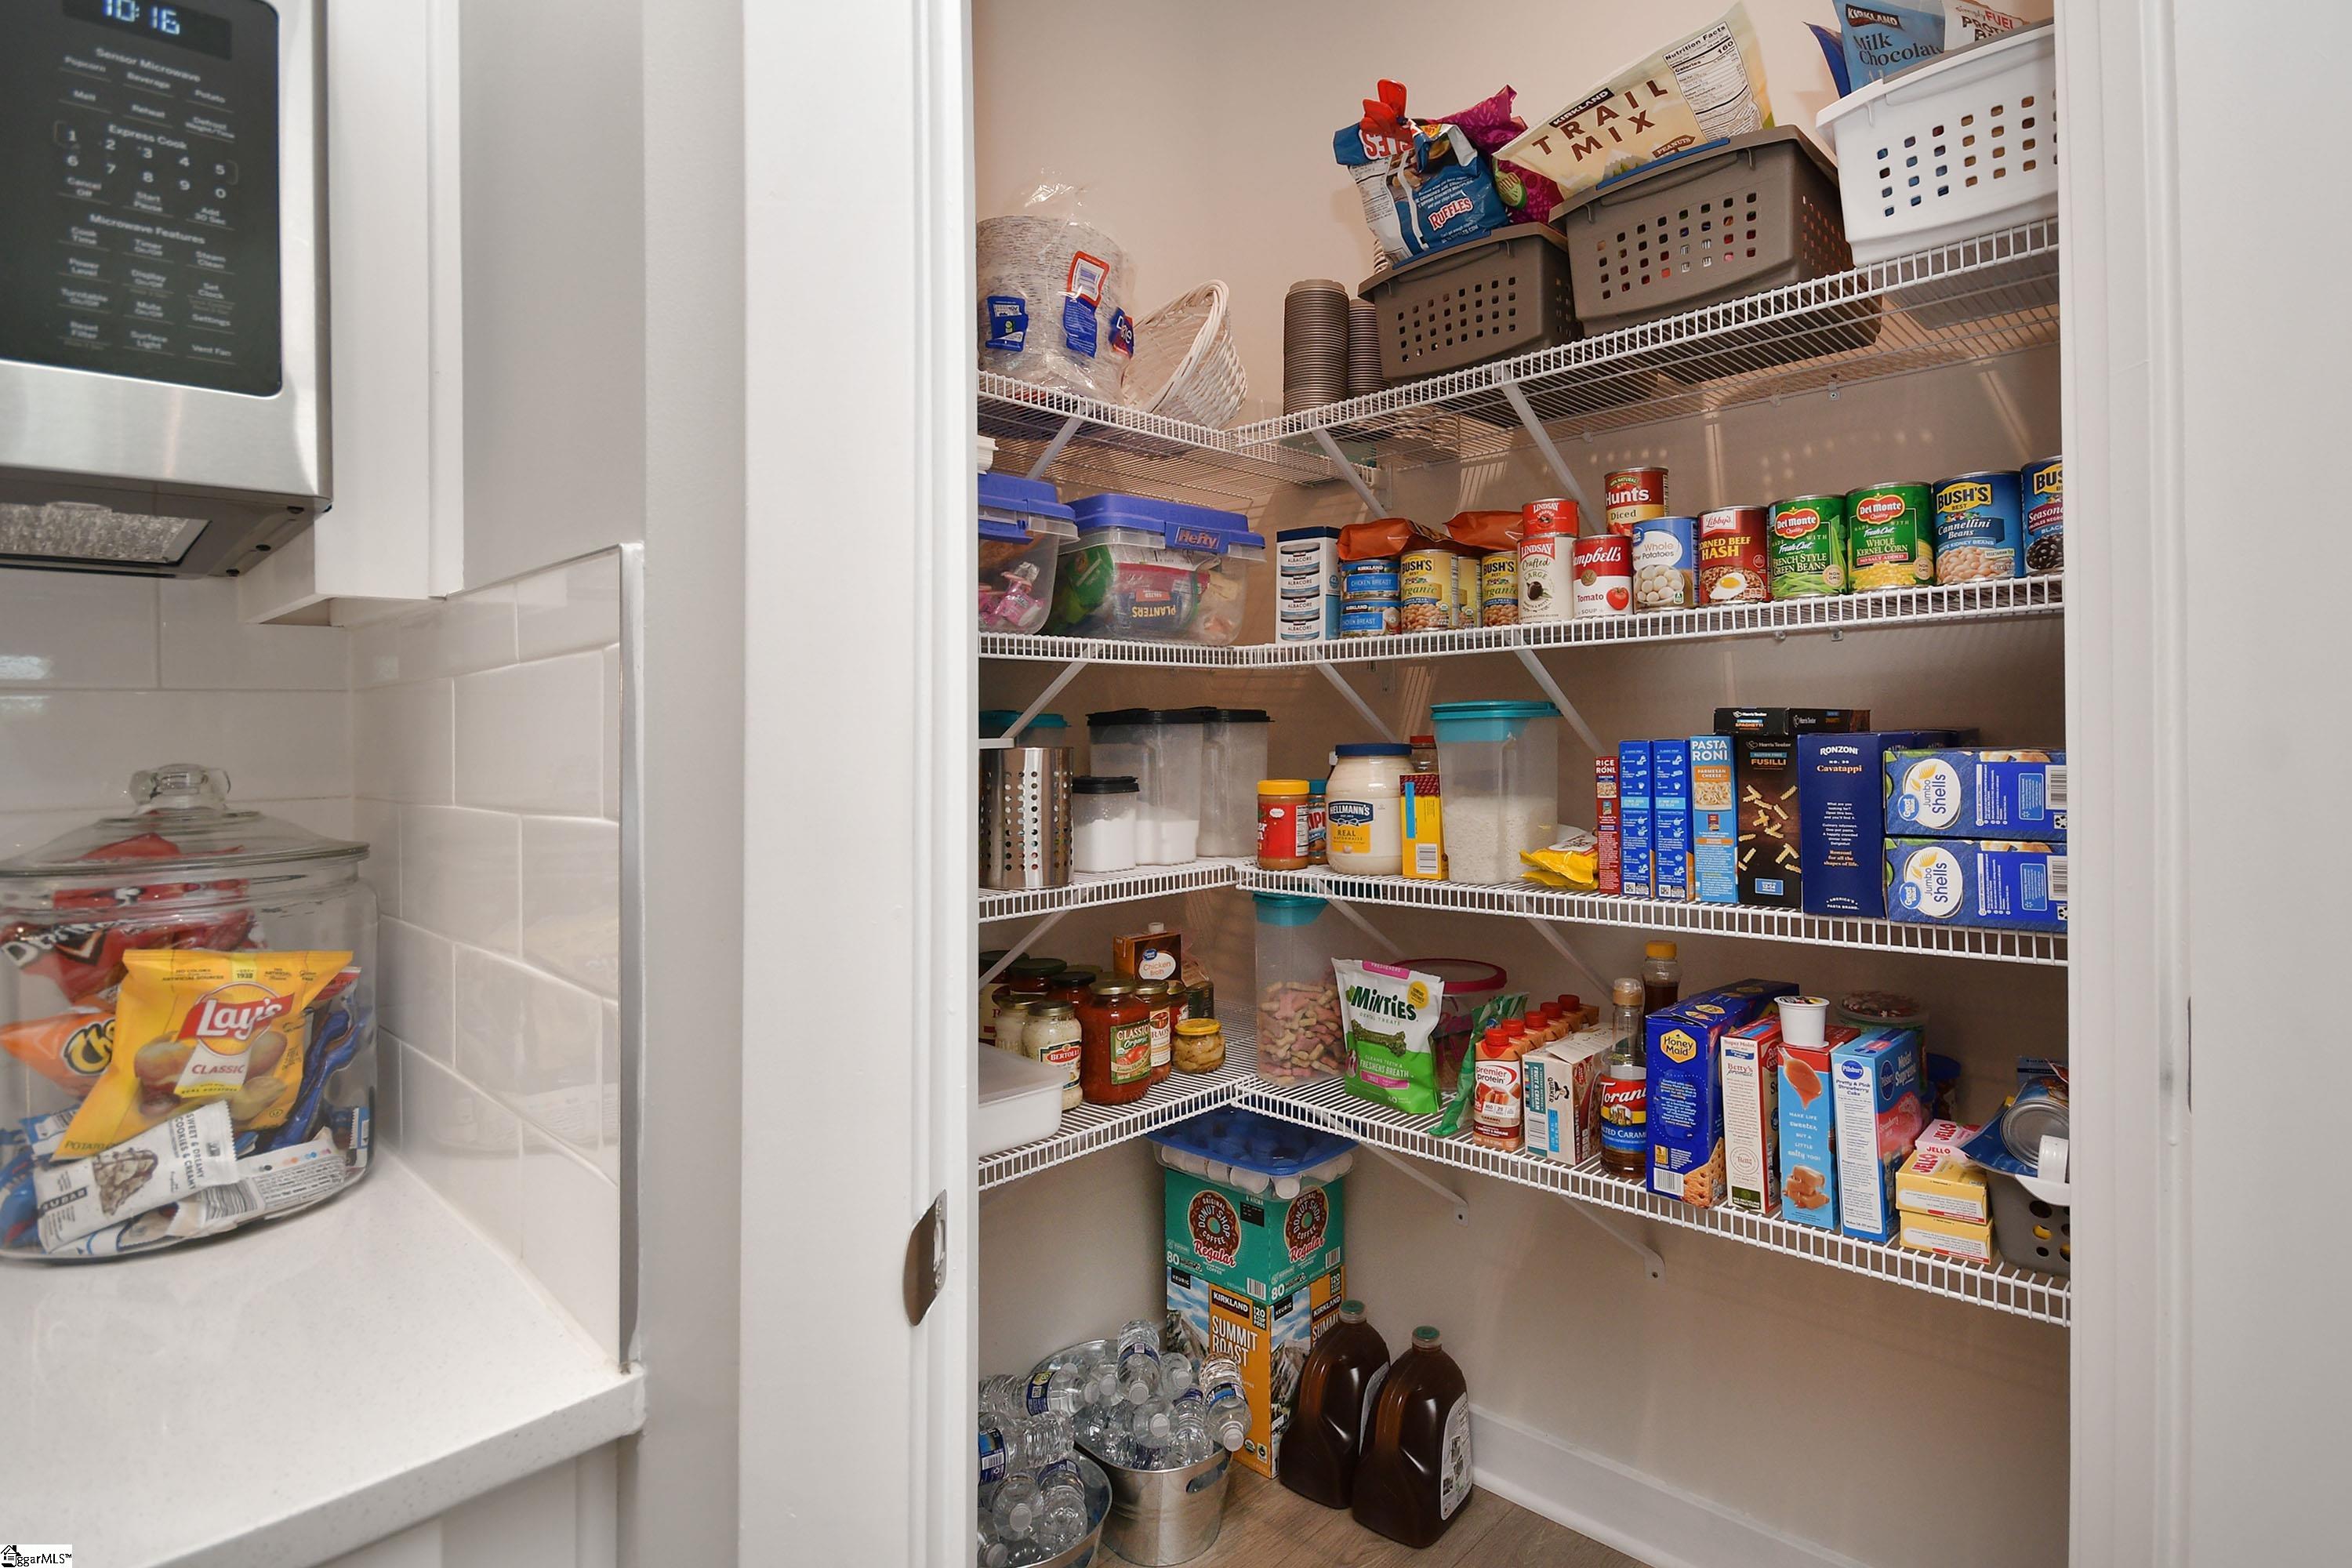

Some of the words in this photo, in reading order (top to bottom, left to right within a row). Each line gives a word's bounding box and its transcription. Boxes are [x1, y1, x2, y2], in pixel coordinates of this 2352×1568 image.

[103, 0, 180, 35] 10:16
[1847, 7, 1898, 27] KIRKLAND
[1664, 39, 1701, 60] Nutrition
[1702, 25, 1726, 41] Facts
[1853, 32, 1893, 49] Milk
[64, 56, 107, 73] Popcorn
[96, 47, 137, 65] Sensor
[140, 59, 201, 82] Microwave
[194, 89, 226, 103] Potato
[1552, 90, 1610, 126] KIRKLAND
[1532, 80, 1668, 155] TRAIL
[108, 124, 156, 143] Express
[157, 136, 187, 150] Cook
[1570, 110, 1656, 162] MIX
[69, 130, 77, 142] 1
[106, 139, 116, 151] 2
[143, 147, 154, 158] 3
[179, 156, 190, 167] 4
[216, 165, 225, 176] 5
[1657, 136, 1693, 156] PEANUTS
[67, 156, 78, 166] 6
[107, 164, 116, 174] 7
[143, 172, 154, 183] 8
[180, 180, 191, 191] 9
[215, 188, 227, 199] 0
[1428, 198, 1473, 230] RUFFLES
[89, 212, 154, 234] Microwave
[154, 227, 205, 245] Features
[1938, 487, 1991, 510] BUSH'S
[1533, 503, 1559, 514] LINDSAY
[1610, 510, 1636, 521] Diced
[1860, 505, 1872, 514] Del
[1873, 502, 1901, 512] Monte
[1705, 516, 1732, 528] Libby's
[1777, 520, 1788, 530] Del
[1788, 514, 1817, 527] Monte
[1938, 518, 1991, 535] Cannellini
[1178, 528, 1218, 547] Hefty
[1728, 536, 1751, 546] BEEF
[1948, 530, 1974, 539] Beans
[1644, 542, 1674, 552] Whole
[1866, 538, 1894, 547] WHOLE
[1521, 543, 1554, 558] LINDSAY
[1573, 546, 1621, 568] ampbell's
[1642, 550, 1675, 559] Potatoes
[1702, 545, 1739, 561] HASH
[1800, 552, 1827, 562] STYLE
[1857, 547, 1882, 557] KERNEL
[1884, 544, 1907, 554] CORN
[1522, 557, 1550, 572] Crafted
[1774, 564, 1796, 576] GREEN
[1797, 561, 1826, 572] BEANS
[1524, 571, 1548, 581] LARGE
[1577, 593, 1604, 603] Tomato
[1131, 604, 1177, 618] PLANTERS
[1692, 740, 1727, 750] PASTA
[1820, 746, 1859, 756] RONZONI
[1693, 750, 1729, 761] RONI
[1817, 765, 1863, 774] Cavatappi
[1932, 774, 1946, 815] Shells
[1330, 804, 1370, 815] HELLMANN'S
[1933, 862, 1948, 903] Shells
[1143, 961, 1171, 971] Chicken
[197, 997, 282, 1041] Lay's
[1664, 1036, 1693, 1051] Honey
[1666, 1045, 1689, 1056] Maid
[1050, 1048, 1080, 1061] BERTOLLI
[191, 1064, 246, 1075] CLASSIC
[1359, 1059, 1385, 1073] FRESHENS
[1385, 1064, 1410, 1078] BREATH
[1476, 1066, 1507, 1077] premier
[1727, 1062, 1753, 1073] Betty's
[1842, 1065, 1864, 1075] Pillsbury
[1477, 1074, 1504, 1084] protein
[1836, 1079, 1853, 1087] Pretty
[1838, 1084, 1870, 1094] Strawberry
[186, 1112, 198, 1139] SWEET
[176, 1116, 189, 1152] COOKIES
[183, 1160, 196, 1190] CREAMY
[1788, 1149, 1806, 1160] salty
[191, 1147, 205, 1178] DREAMY
[1203, 1198, 1225, 1211] ORIGINAL
[1297, 1192, 1316, 1207] ORIGINAL
[1198, 1205, 1215, 1228] DONUT
[1217, 1207, 1230, 1238] SHOP
[1294, 1203, 1308, 1234] DONUT
[1308, 1199, 1320, 1222] SHOP
[1203, 1231, 1225, 1245] COFFEE
[1297, 1225, 1317, 1240] COFFEE
[1193, 1239, 1236, 1269] Regular
[1288, 1235, 1326, 1264] Regular
[1167, 1251, 1180, 1265] 80
[1172, 1275, 1189, 1286] KEURIG
[1330, 1273, 1341, 1284] 120
[1271, 1283, 1285, 1301] 80
[1213, 1292, 1249, 1312] KIRKLAND
[1276, 1302, 1292, 1316] KEURIG
[1313, 1295, 1341, 1317] KIRKLAND
[1253, 1306, 1265, 1318] 120
[1212, 1316, 1258, 1352] SUMMIT
